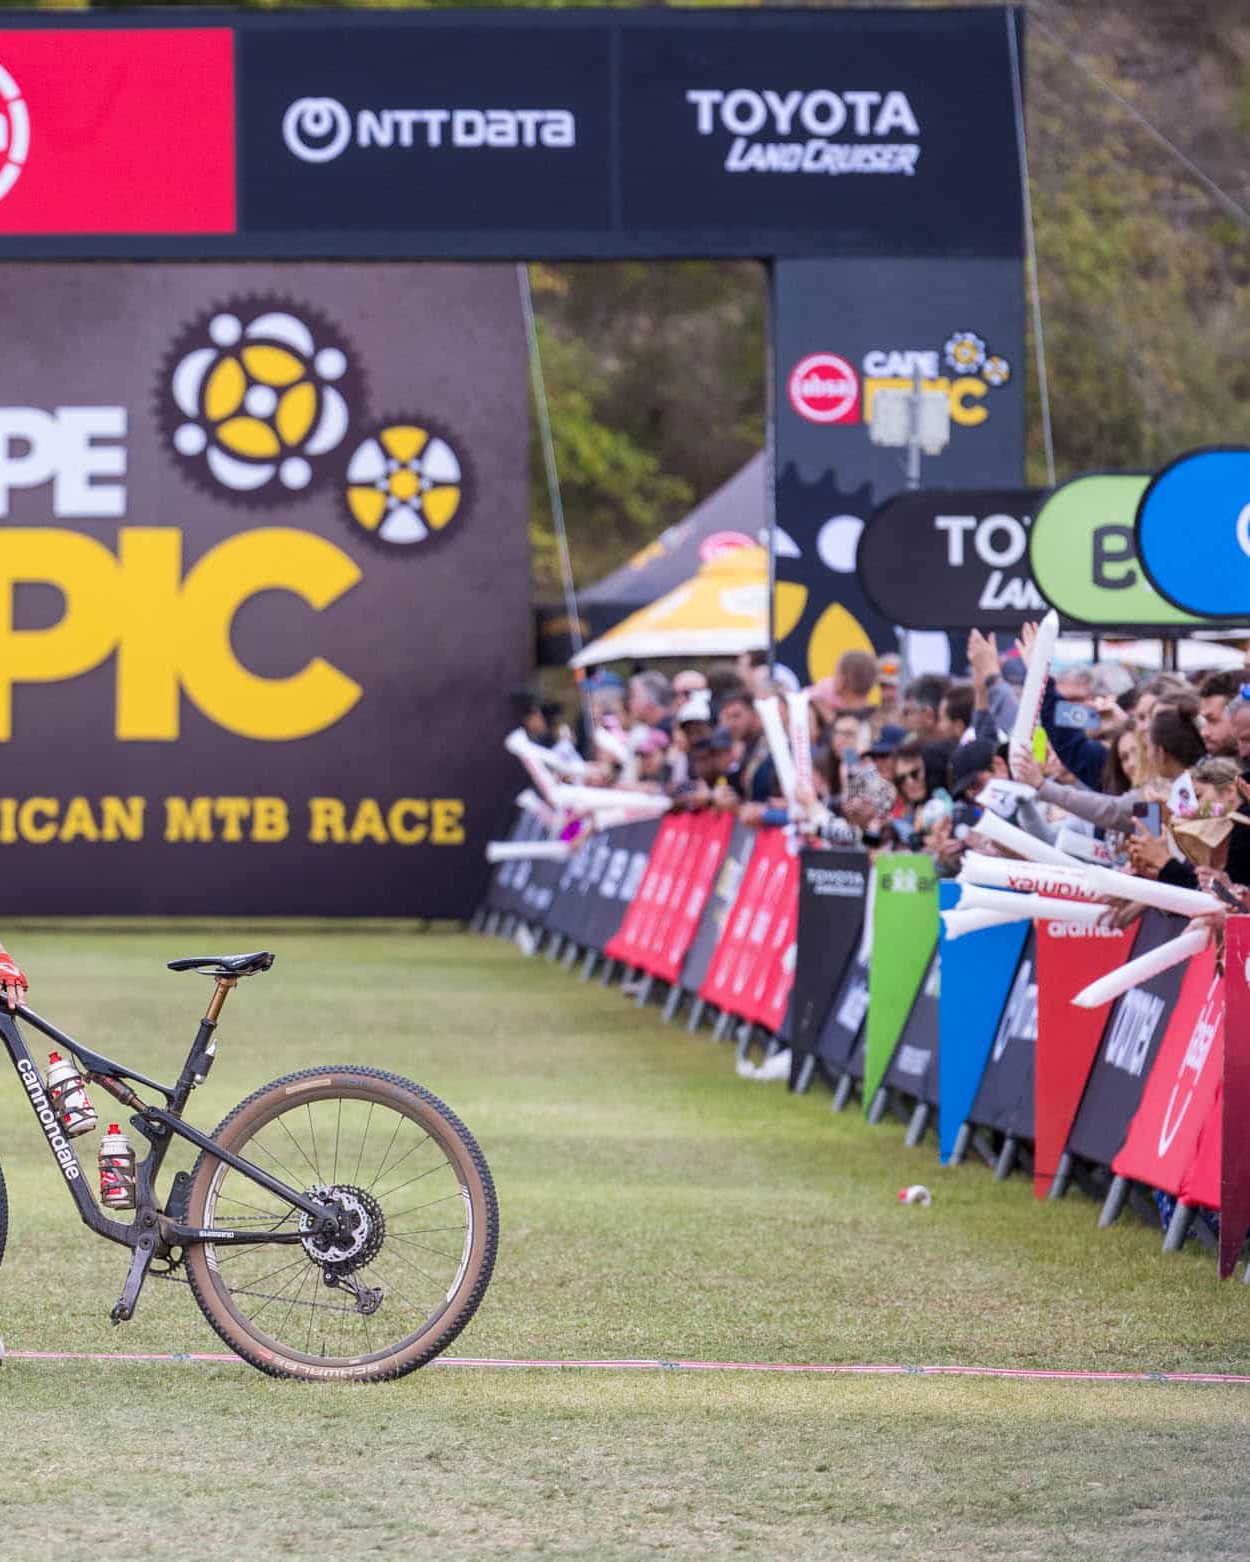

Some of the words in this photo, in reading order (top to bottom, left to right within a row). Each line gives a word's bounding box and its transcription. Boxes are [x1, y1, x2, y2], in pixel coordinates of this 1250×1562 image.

[356, 108, 450, 148] NTT
[686, 88, 920, 137] TOYOTA
[724, 137, 802, 174] LAND
[801, 138, 921, 177] CRUISER
[863, 350, 939, 378] CAPE
[164, 798, 290, 842] MTB
[308, 797, 467, 844] RACE
[17, 1058, 80, 1180] cannondale
